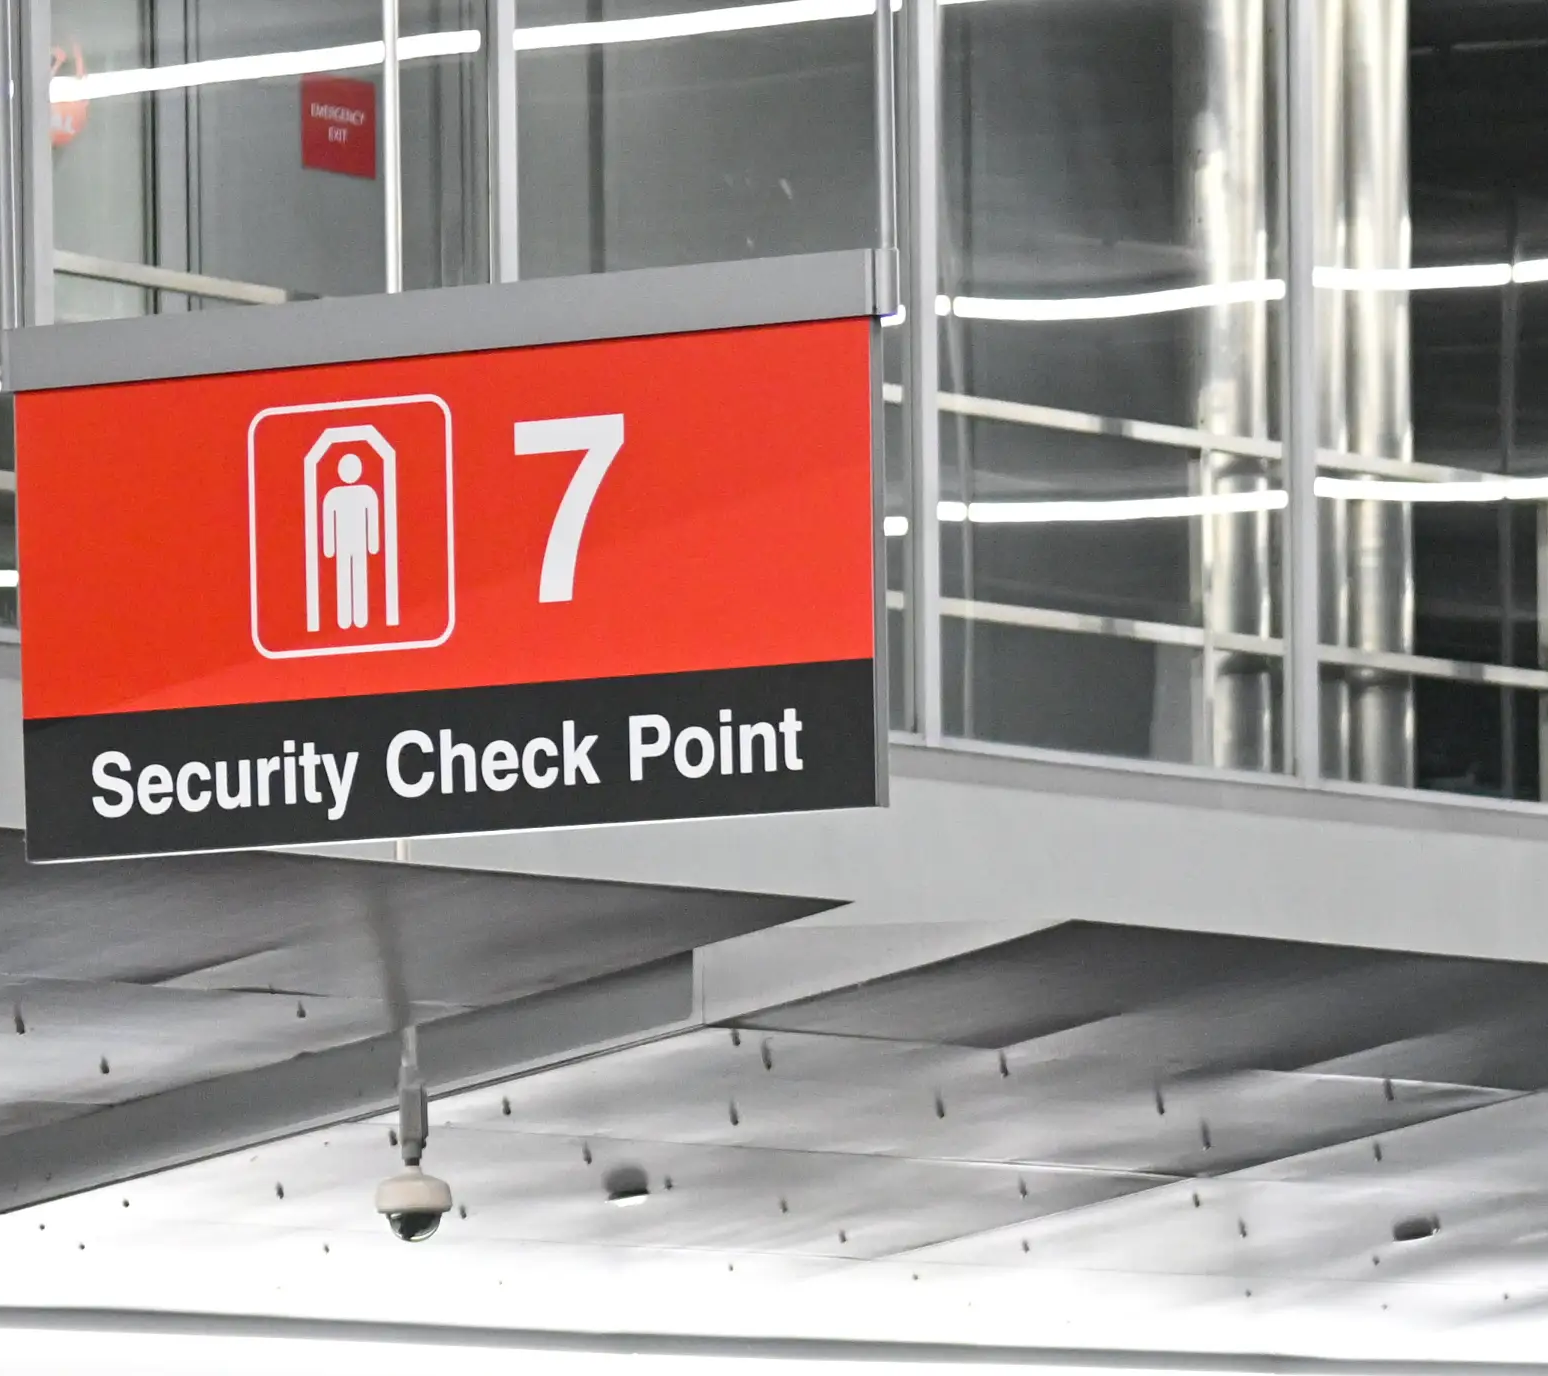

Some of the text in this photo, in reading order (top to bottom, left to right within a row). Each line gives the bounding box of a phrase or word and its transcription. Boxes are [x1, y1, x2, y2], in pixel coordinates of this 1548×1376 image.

[310, 102, 365, 126] EMERGENCY
[328, 126, 348, 145] EXIT
[512, 412, 626, 605] 7
[91, 707, 804, 821] Security Check Point
